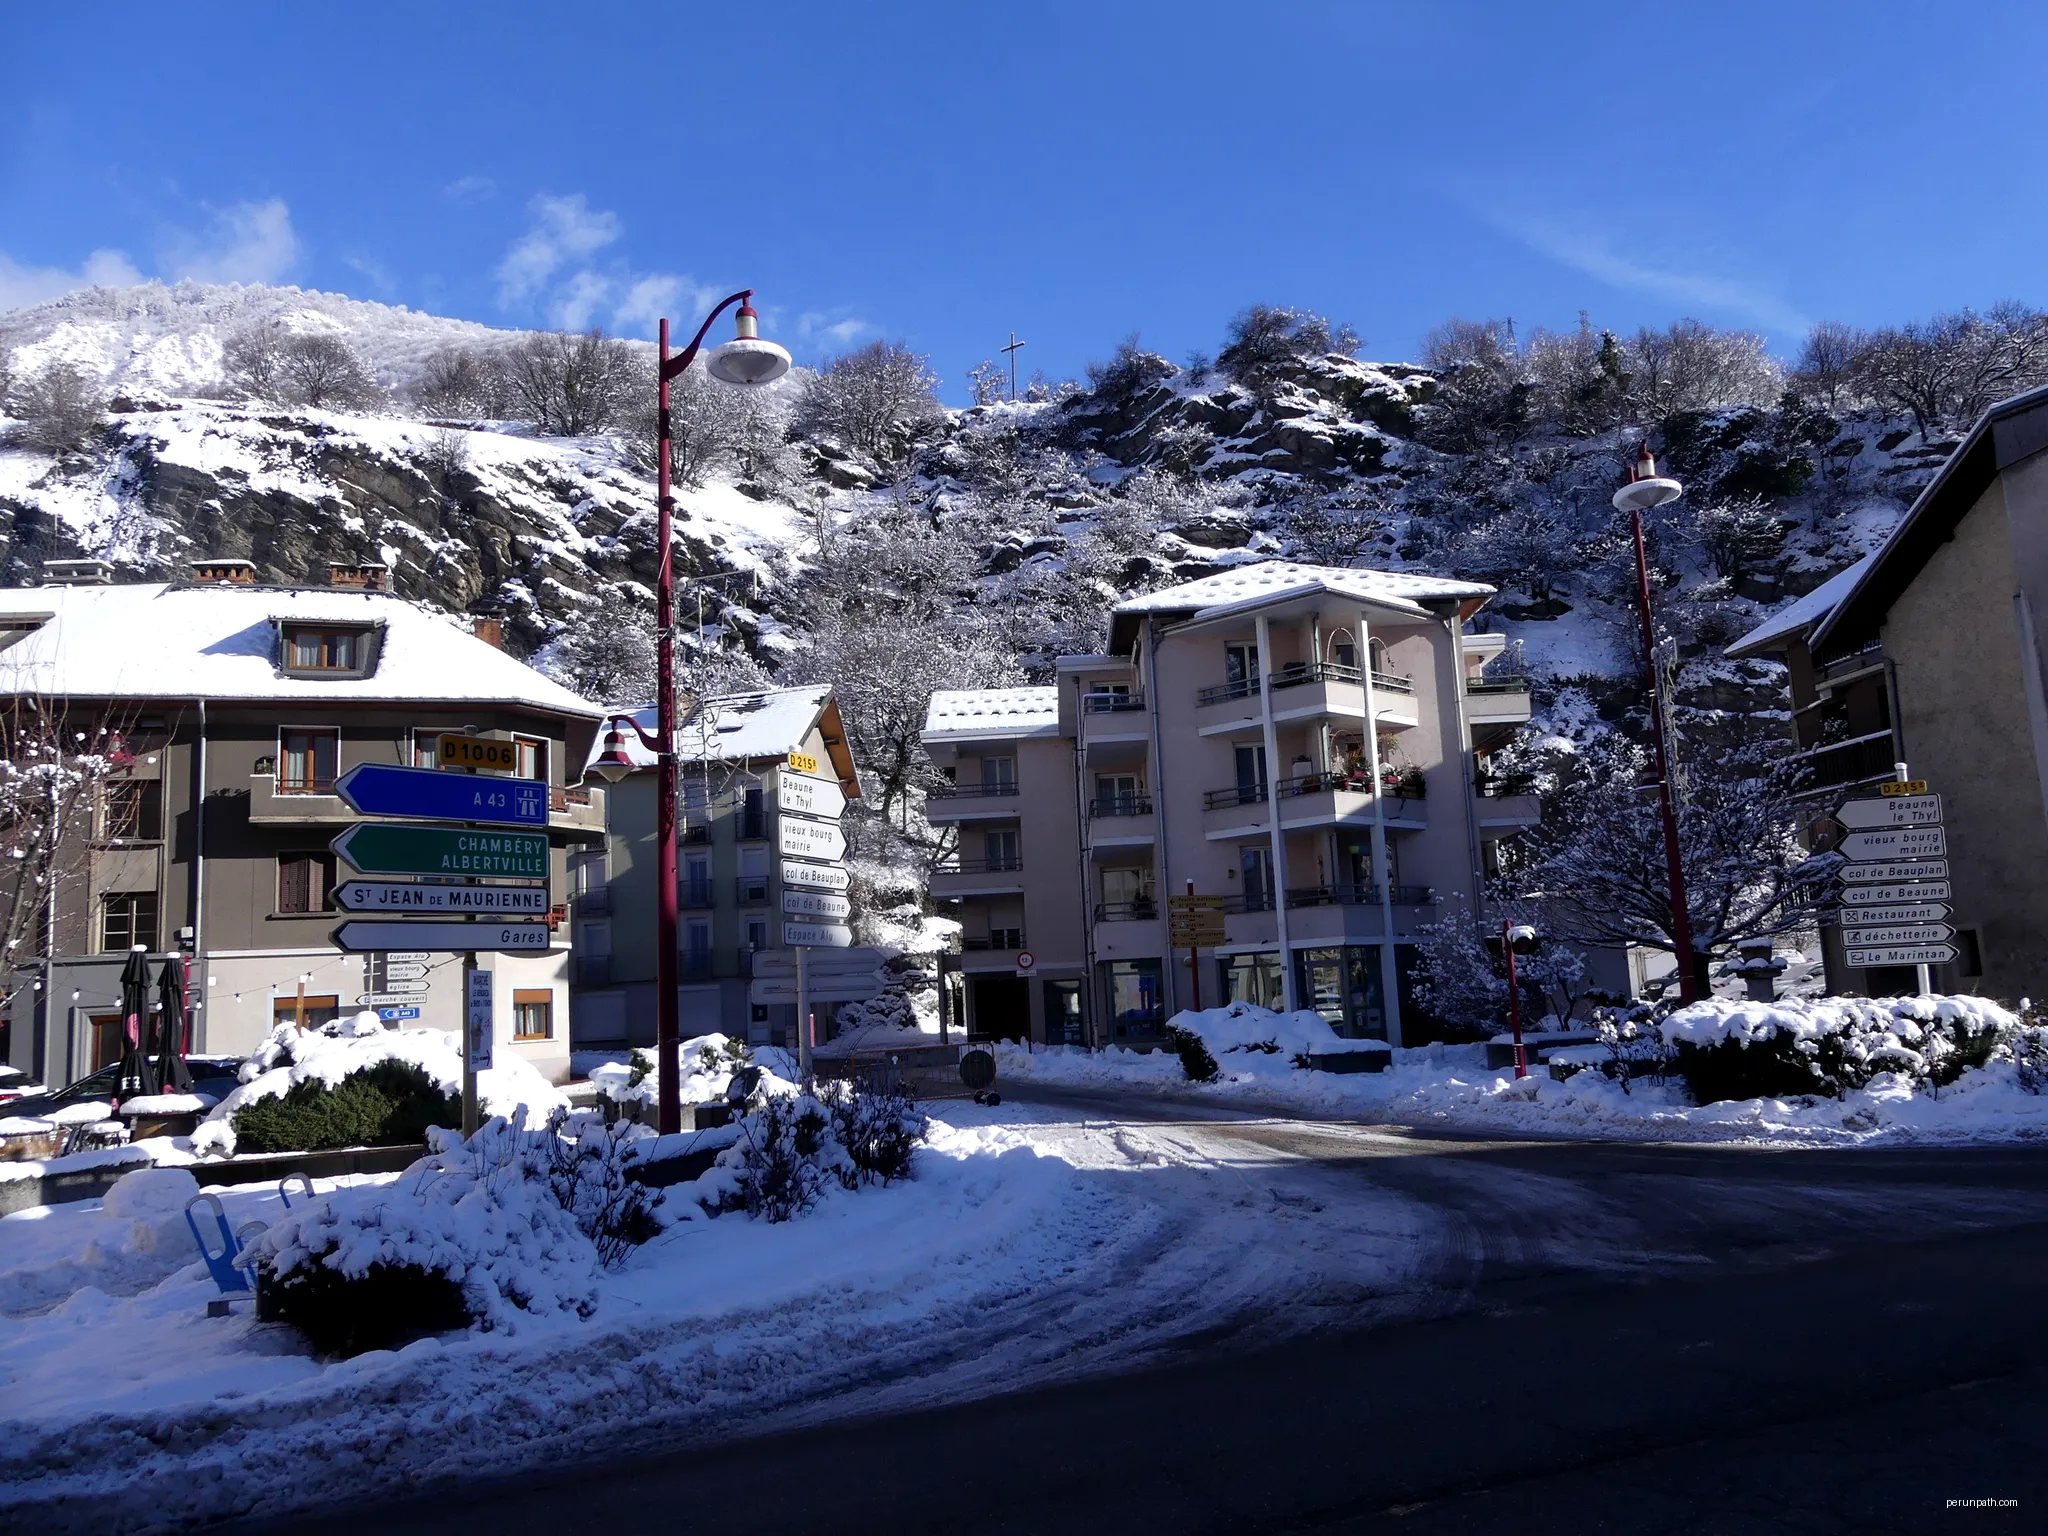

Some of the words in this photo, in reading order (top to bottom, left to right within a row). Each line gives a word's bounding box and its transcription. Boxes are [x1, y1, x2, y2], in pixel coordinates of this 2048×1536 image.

[445, 742, 456, 758] D
[462, 744, 512, 764] 1006
[790, 754, 796, 766] D
[783, 777, 813, 794] Beaune
[1883, 784, 1891, 794] D
[473, 792, 482, 806] A
[487, 793, 506, 807] 43
[783, 793, 791, 804] le
[796, 794, 812, 810] Thyl
[1889, 800, 1935, 811] Beaune
[1893, 812, 1904, 822] le
[1912, 810, 1937, 822] Thyl
[784, 822, 806, 837] vieux
[810, 826, 833, 843] bourg
[1864, 835, 1896, 845] vieux
[1903, 832, 1939, 844] bourg
[458, 837, 542, 855] CHAMBÉRY
[784, 839, 811, 852] mairie
[1900, 844, 1940, 855] mairie
[441, 854, 543, 873] ALBERTVILLE
[785, 867, 798, 880] col
[800, 868, 809, 881] de
[811, 870, 845, 887] Beauplan
[1848, 868, 1865, 879] col
[1870, 867, 1883, 877] de
[1888, 865, 1943, 878] Beauplan
[379, 889, 424, 905] JEAN
[449, 891, 542, 908] MAURIENNE
[1852, 890, 1870, 900] col
[1877, 888, 1891, 899] de
[1898, 886, 1944, 898] Beaune
[786, 895, 800, 909] col
[803, 897, 813, 910] de
[816, 899, 846, 913] Beaune
[1862, 909, 1932, 921] Restaurant
[501, 929, 544, 944] Gares
[787, 927, 816, 942] Espace
[820, 928, 834, 942] Alu
[1865, 929, 1938, 942] déchetterie
[1868, 952, 1881, 962] Le
[1887, 950, 1945, 961] Marintan
